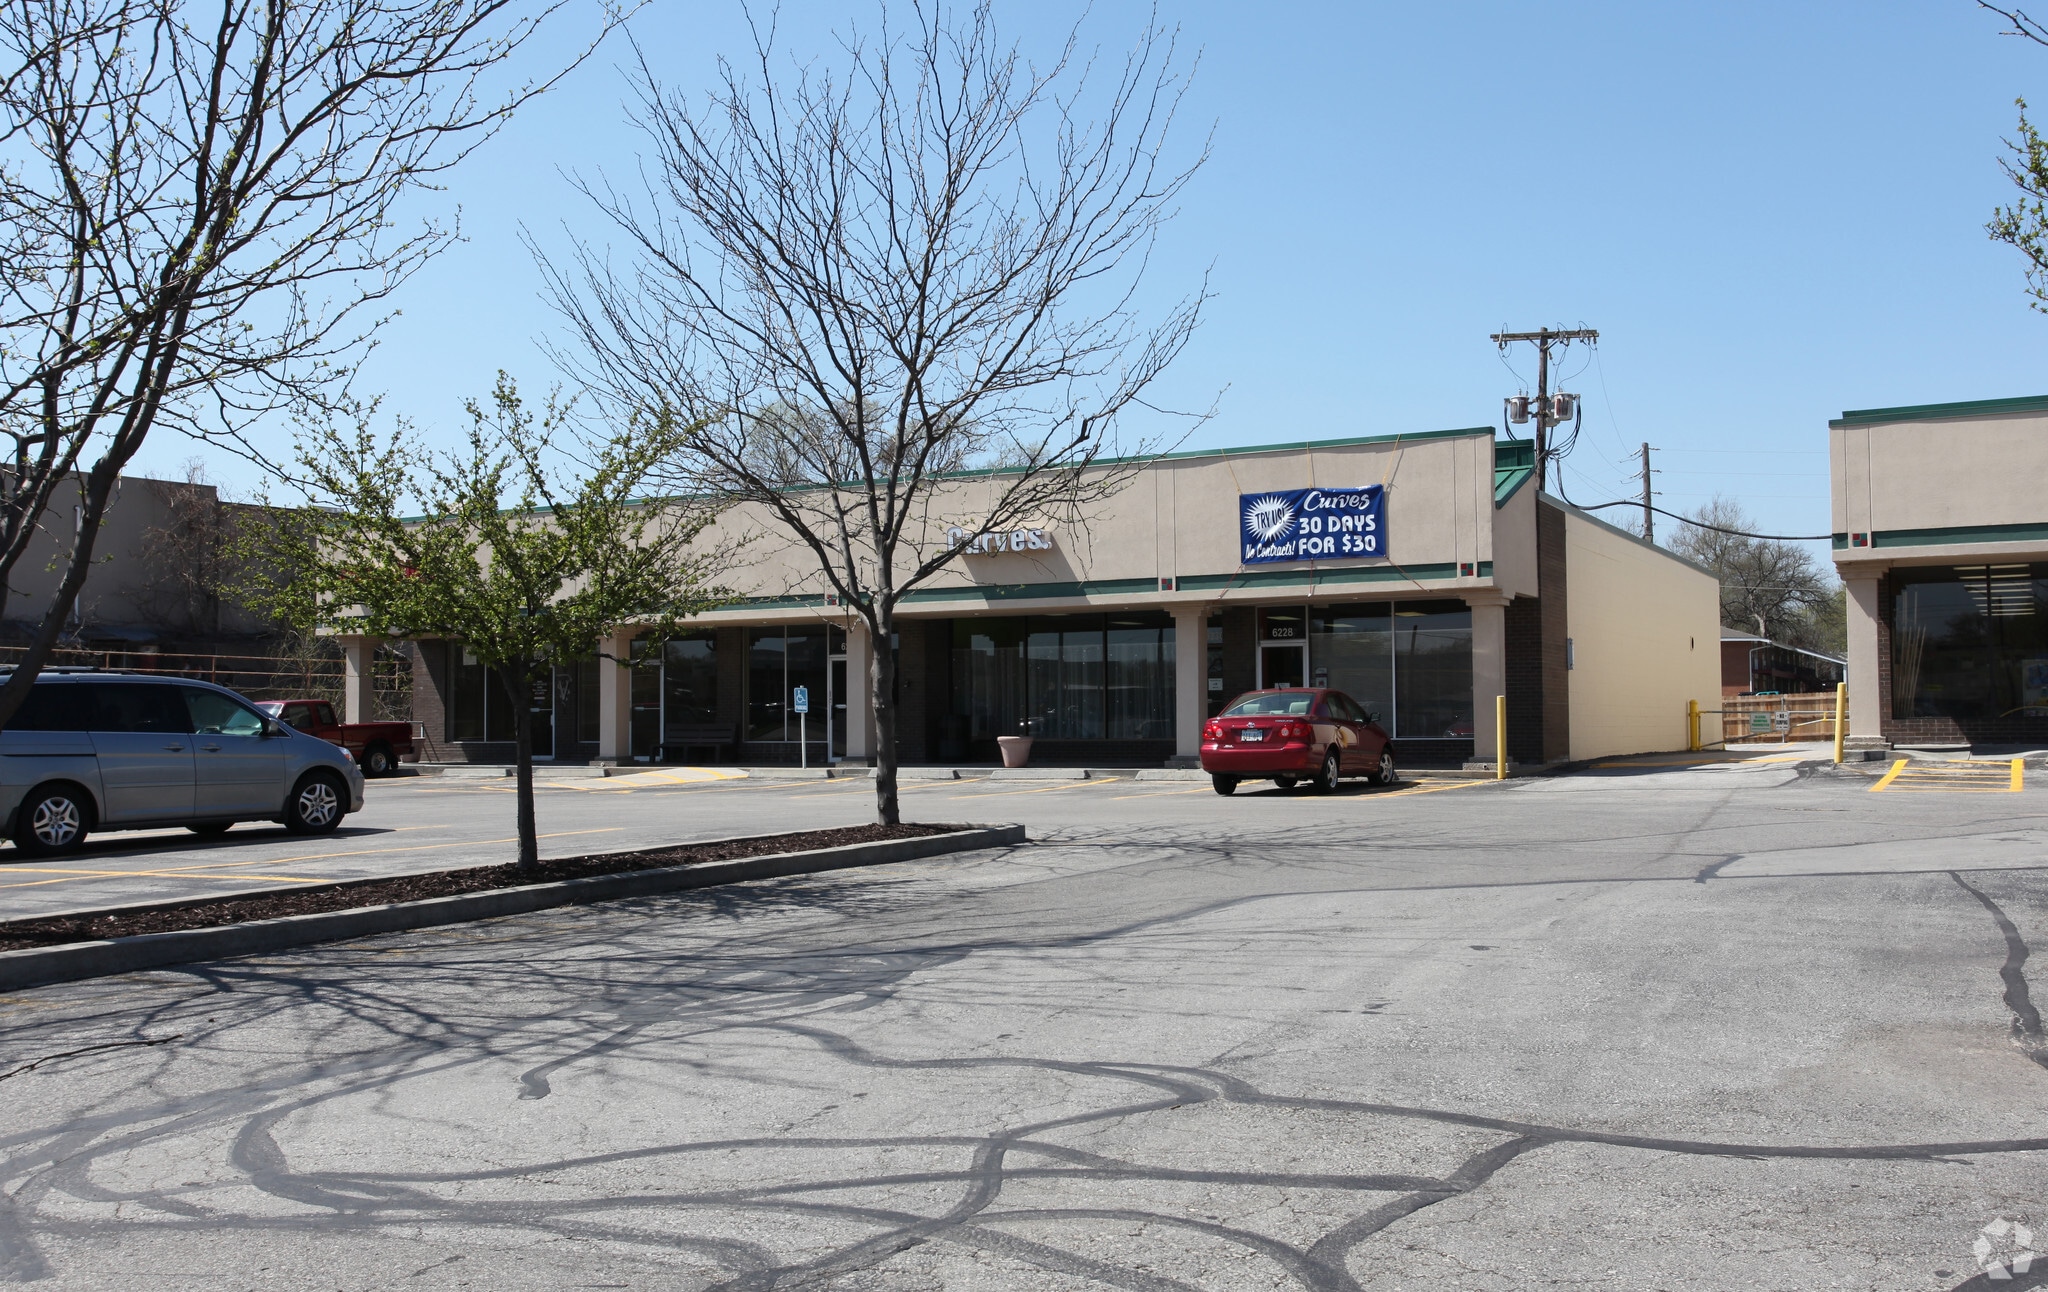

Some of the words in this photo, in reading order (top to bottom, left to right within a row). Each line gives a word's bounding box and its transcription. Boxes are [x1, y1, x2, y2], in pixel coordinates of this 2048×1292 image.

[1303, 490, 1370, 511] Curves
[1255, 511, 1270, 529] TRY
[1272, 507, 1286, 526] US!
[1299, 516, 1322, 535] 30
[1328, 514, 1376, 533] DAYS
[1245, 543, 1255, 559] No
[1256, 540, 1296, 558] Contracts!
[1299, 537, 1335, 555] FOR
[1342, 533, 1376, 552] $30
[1272, 628, 1293, 637] 6228
